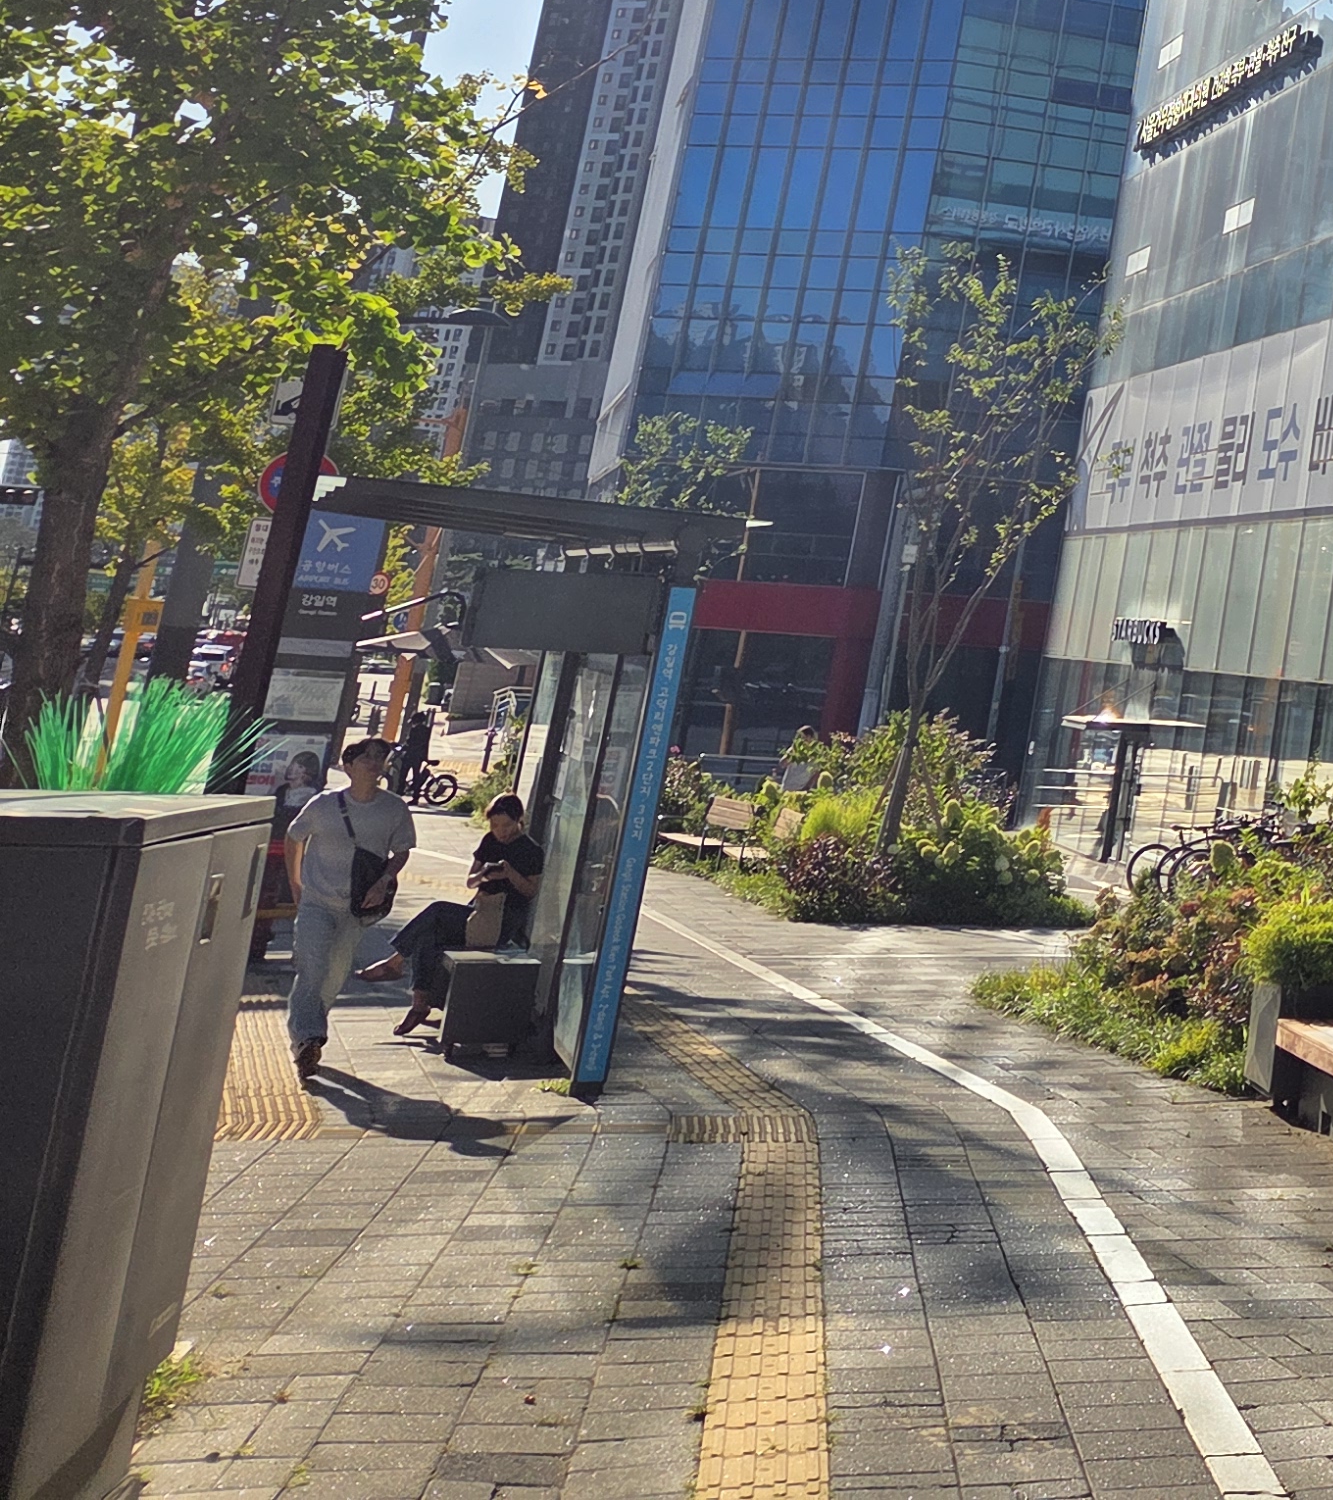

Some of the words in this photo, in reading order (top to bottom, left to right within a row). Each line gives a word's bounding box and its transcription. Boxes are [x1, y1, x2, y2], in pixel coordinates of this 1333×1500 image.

[1139, 427, 1172, 498] 척추
[1174, 420, 1213, 495] 관절
[1213, 411, 1256, 490] 물리
[1257, 402, 1301, 482] 도수
[300, 559, 352, 575] 공항버스
[371, 578, 386, 590] 30
[301, 594, 338, 607] 강일역
[1111, 619, 1161, 645] STARBUCKS
[662, 643, 679, 681] 강일역
